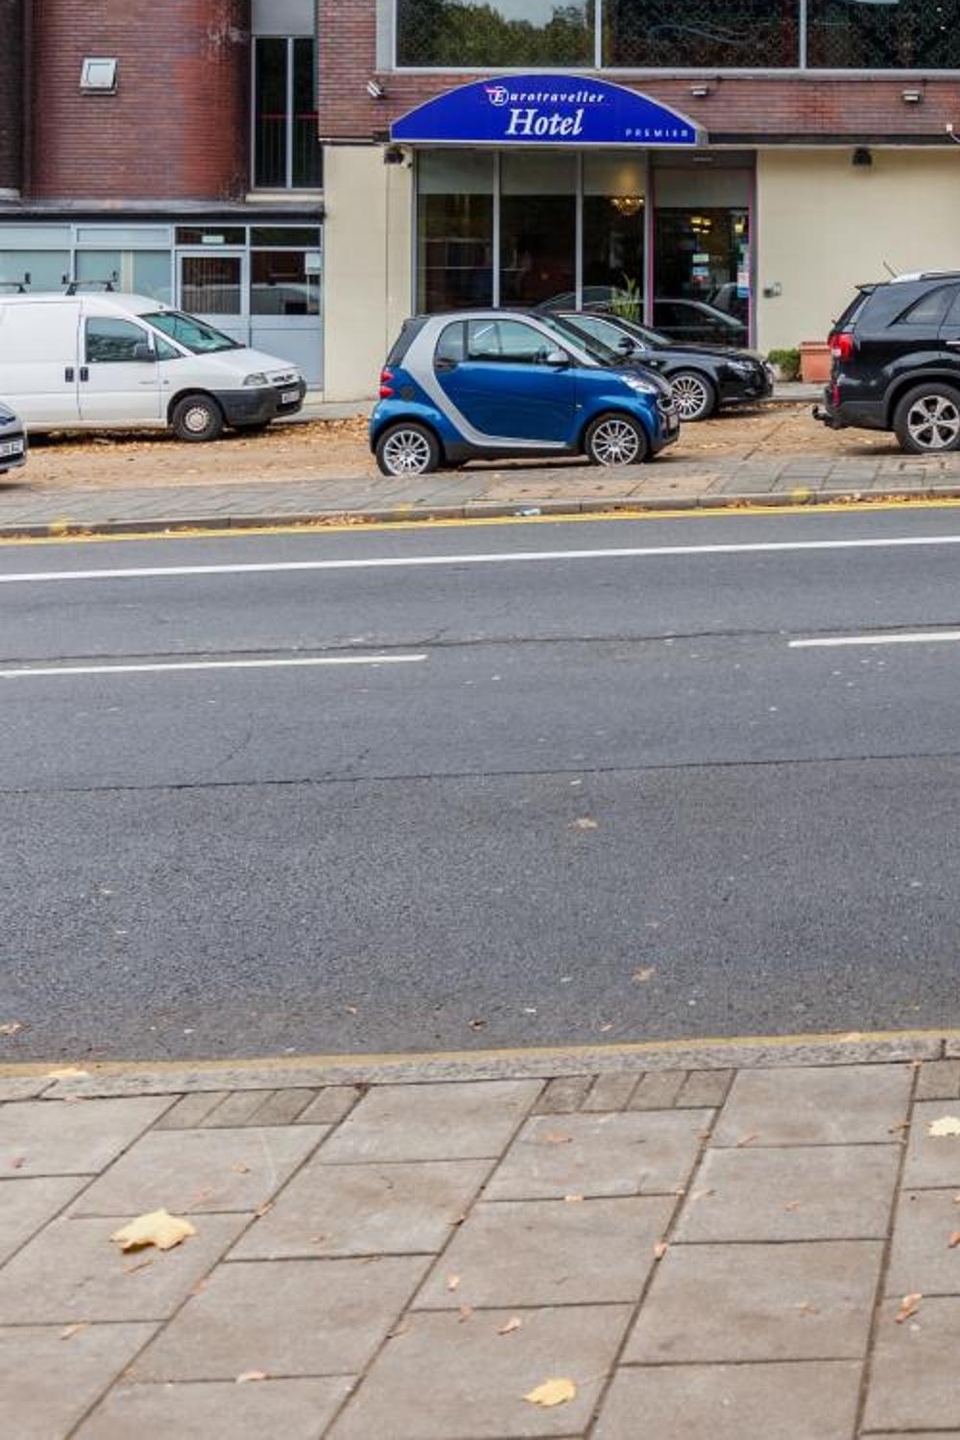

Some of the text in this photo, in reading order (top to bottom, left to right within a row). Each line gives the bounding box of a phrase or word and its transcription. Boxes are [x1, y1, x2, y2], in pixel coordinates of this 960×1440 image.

[492, 88, 605, 104] Eurotraveller
[504, 108, 585, 136] Hotel
[625, 128, 689, 138] PREMIER
